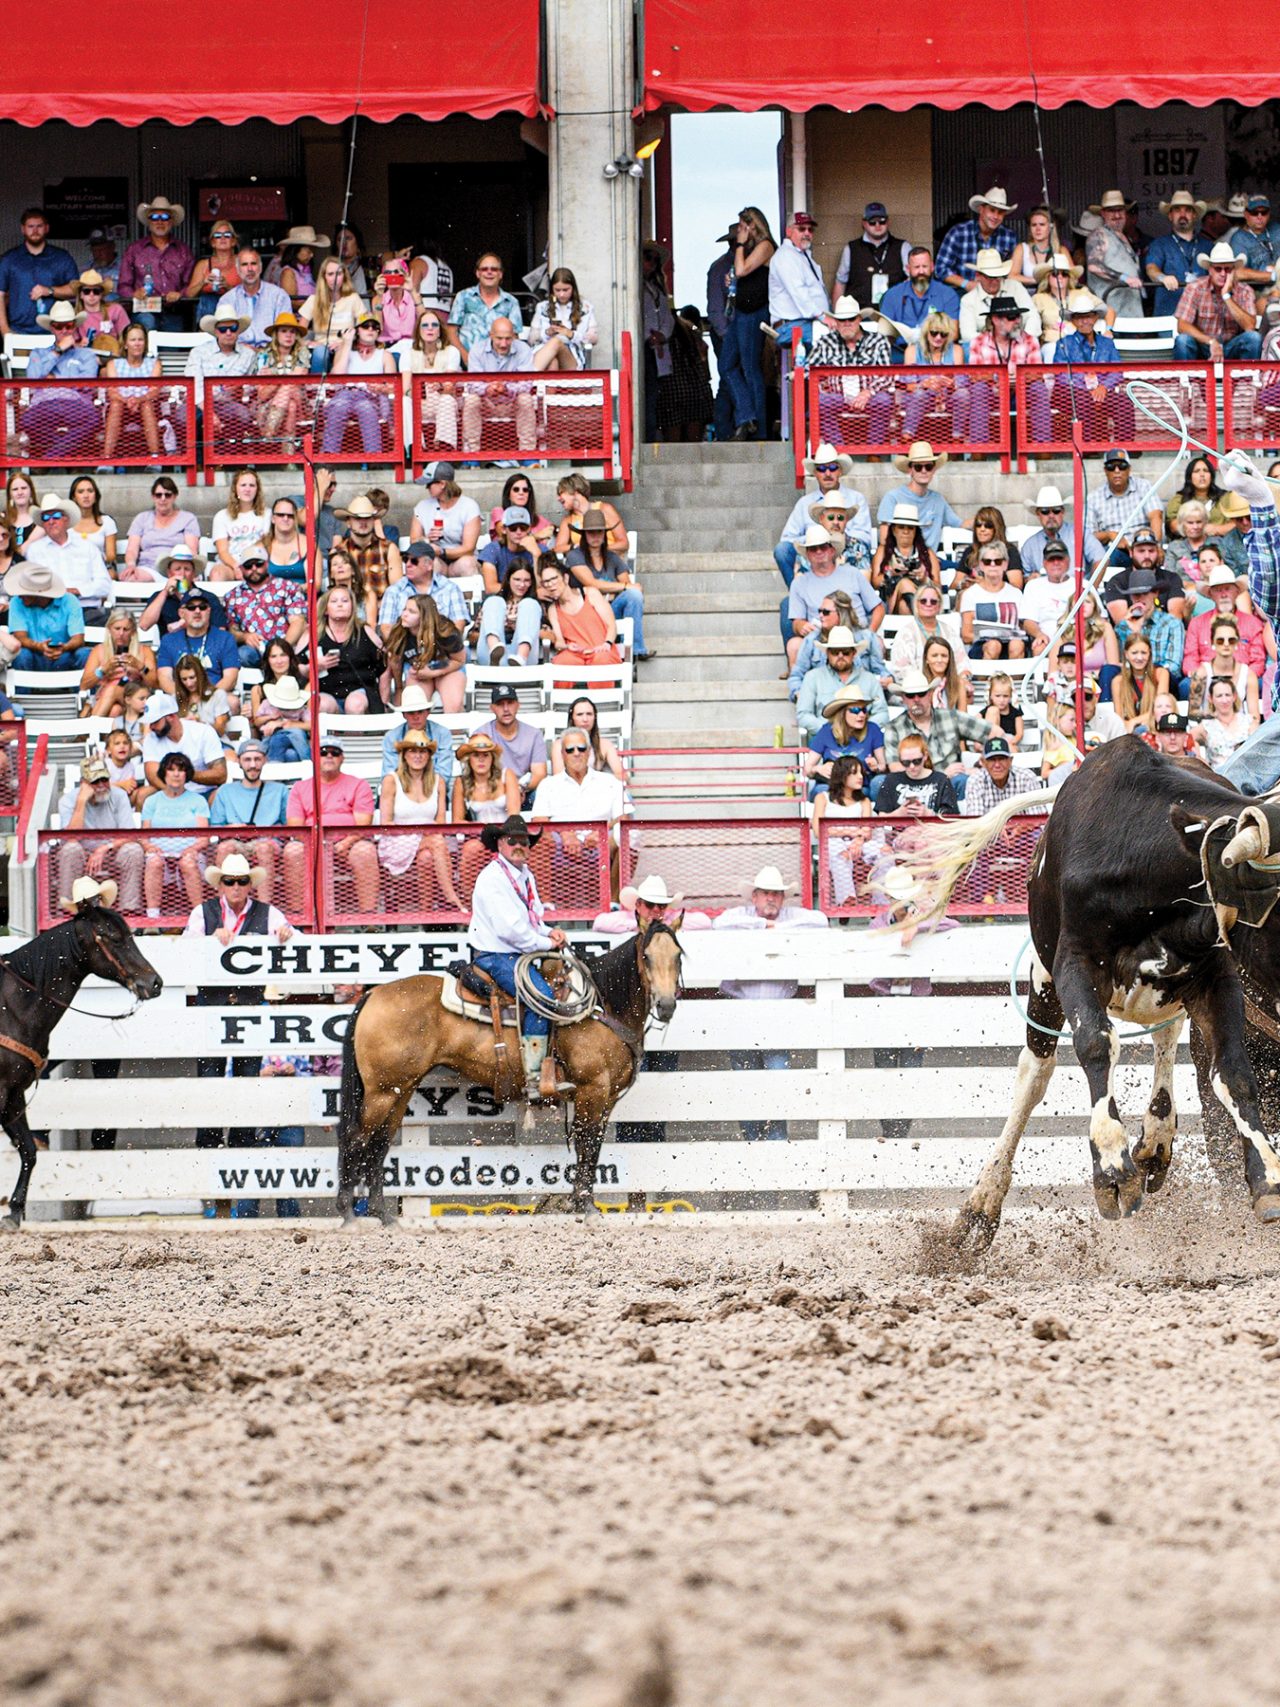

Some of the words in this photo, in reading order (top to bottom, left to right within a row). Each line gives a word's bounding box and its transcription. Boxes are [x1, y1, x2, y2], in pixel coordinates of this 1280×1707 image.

[1143, 149, 1200, 178] 1897
[64, 194, 106, 202] WELCOME
[1142, 182, 1201, 197] SUITE
[218, 1155, 620, 1190] www.drodeo.com
